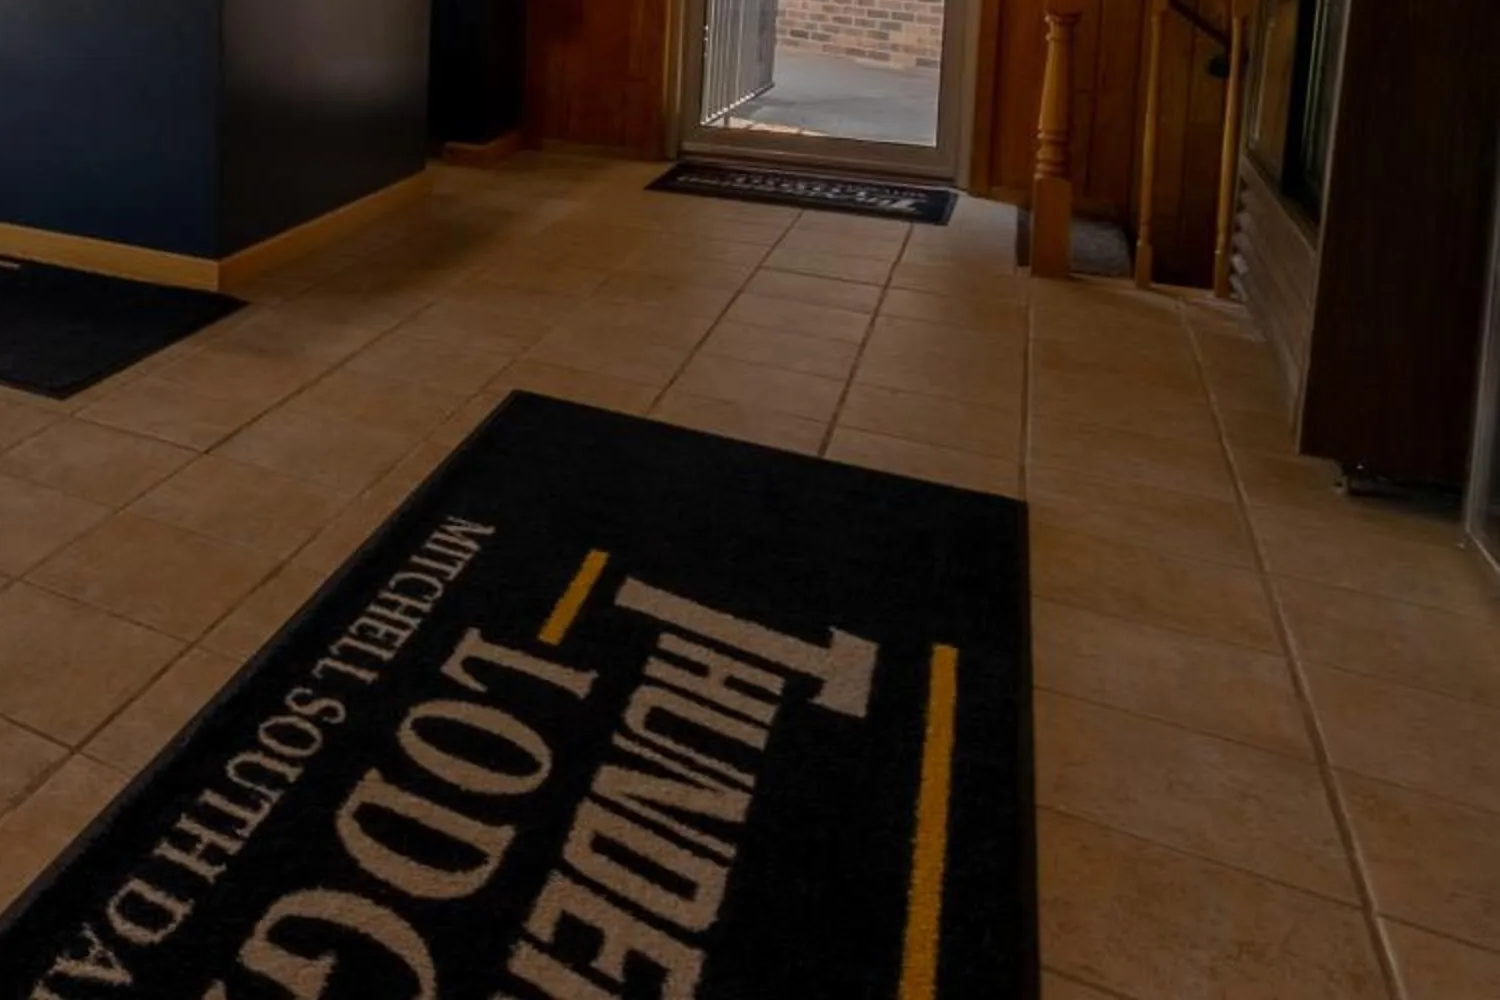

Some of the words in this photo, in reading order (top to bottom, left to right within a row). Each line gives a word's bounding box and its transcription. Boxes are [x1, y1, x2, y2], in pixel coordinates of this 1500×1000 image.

[311, 516, 497, 684] MITCHELL
[153, 687, 347, 884] SOUTH
[198, 626, 599, 1000] LODG
[486, 576, 880, 1000] THUNDE
[24, 876, 197, 1000] DA
